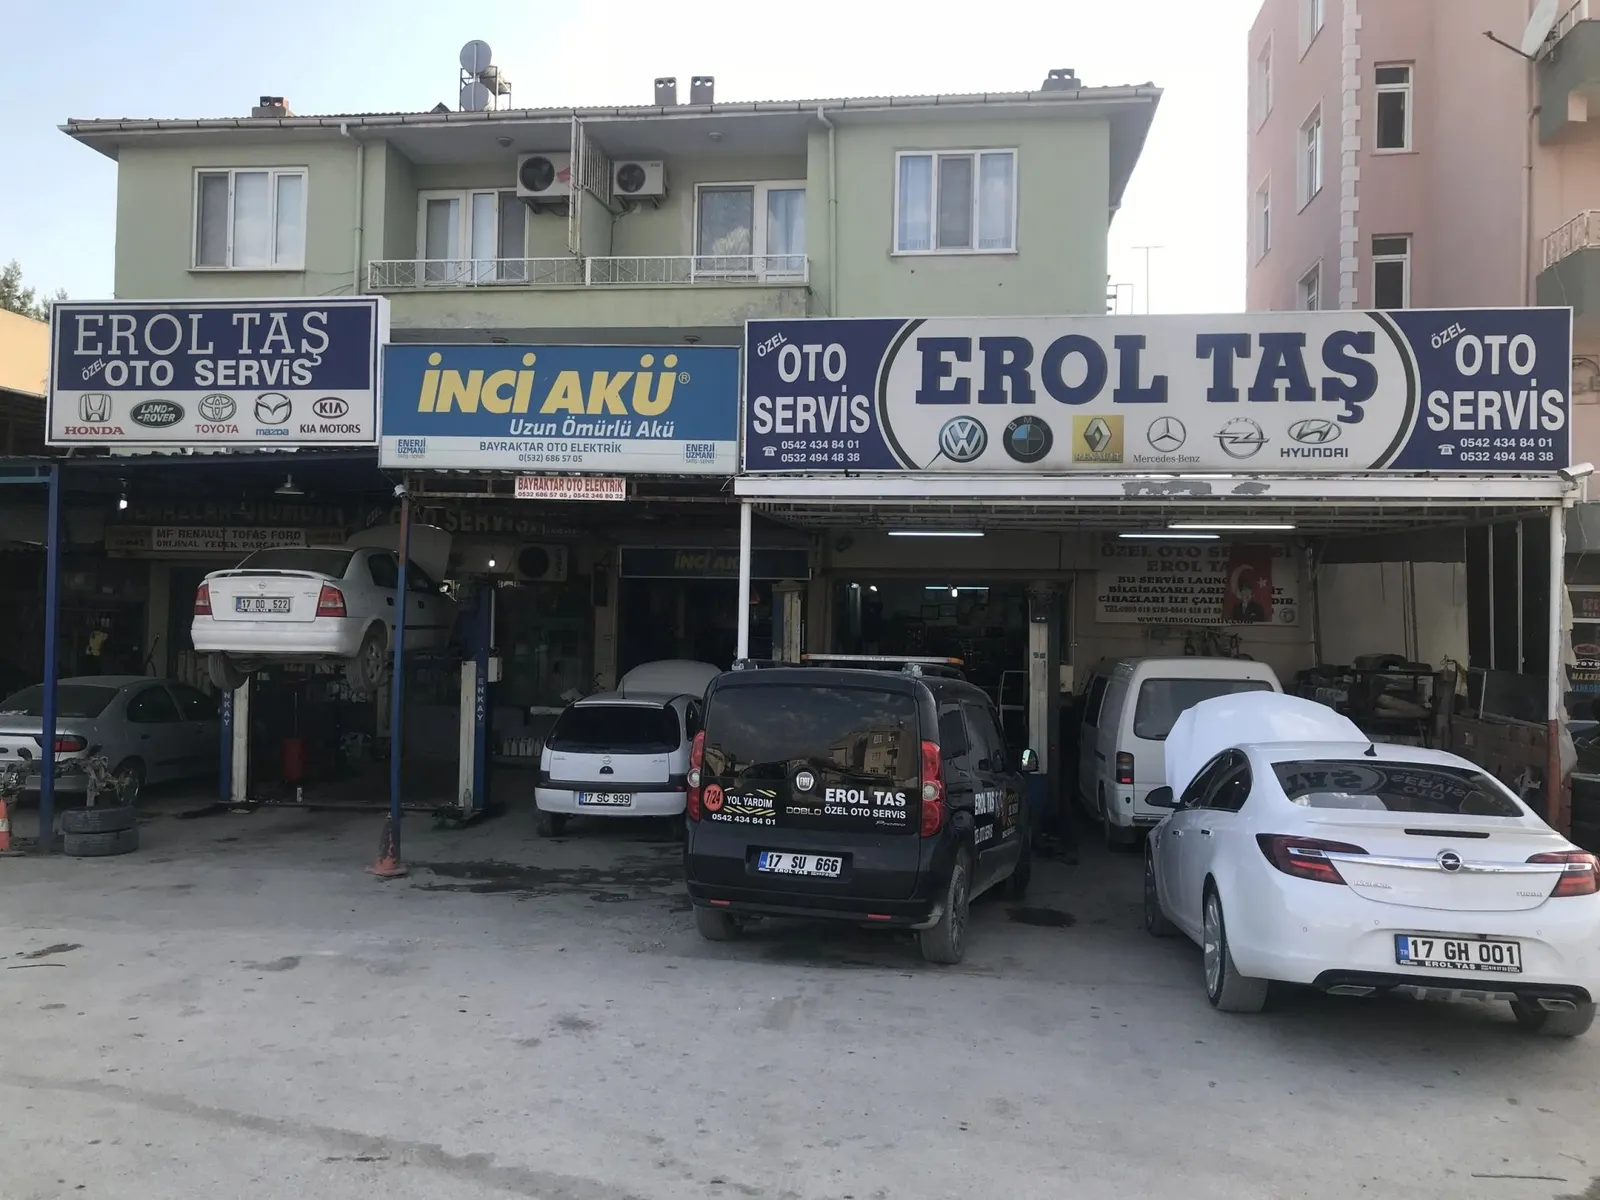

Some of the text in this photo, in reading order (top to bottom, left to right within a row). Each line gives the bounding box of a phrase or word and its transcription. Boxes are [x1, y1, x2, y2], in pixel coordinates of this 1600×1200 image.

[73, 311, 330, 366] EROL TAŞ
[1430, 321, 1466, 350] ÖZEL
[756, 332, 787, 357] ÖZEL
[1455, 334, 1536, 376] OTO
[81, 357, 107, 381] ÖZEL
[777, 343, 847, 383] OTO
[104, 359, 313, 387] OTO SERVİS
[915, 329, 1379, 424] EROL TAŞ
[417, 352, 678, 416] İNCİ AKÜ
[1427, 373, 1565, 431] SERVİS
[752, 384, 871, 434] SERVİS
[64, 426, 125, 435] HONDA
[194, 424, 239, 433] TOYOTA
[300, 424, 361, 433] KIA MOTORS
[509, 416, 675, 438] Uzun Ömürlü Akü
[398, 437, 426, 447] ENERJİ
[479, 440, 622, 453] BAYRAKTAR OTO ELEKTRİK
[686, 442, 714, 452] ENERJİ
[781, 439, 860, 450] 0542 434 84 01
[1460, 437, 1553, 448] 0542 434 84 01
[518, 453, 583, 464] 0(532) 686 57 05
[781, 452, 861, 463] 0532 494 48 38
[1133, 454, 1200, 464] Mercedes-Benz
[1280, 447, 1349, 458] HYUNDAI
[1460, 451, 1554, 461] 0532 494 48 38
[518, 478, 623, 492] BAYRAKTAR OTO ELEKTRİK
[178, 530, 225, 539] RENAULT
[271, 531, 301, 540] FORD
[1157, 545, 1201, 558] OTO
[1146, 560, 1229, 572] EROL TA
[1139, 574, 1185, 584] SERVİS
[242, 600, 251, 609] 17
[273, 600, 288, 609] 522
[584, 793, 630, 804] 17 SC 999
[706, 790, 721, 804] 7/24
[726, 795, 773, 808] YOL YARDIM
[825, 788, 868, 804] EROL
[786, 806, 821, 815] DOBLO
[824, 803, 907, 819] ÖZEL OTO SERVİS
[711, 813, 776, 826] 0542 434 84 01
[768, 854, 839, 873] 17 SU 666
[1411, 939, 1515, 965] 17 GH 001
[1425, 961, 1453, 969] EROL
